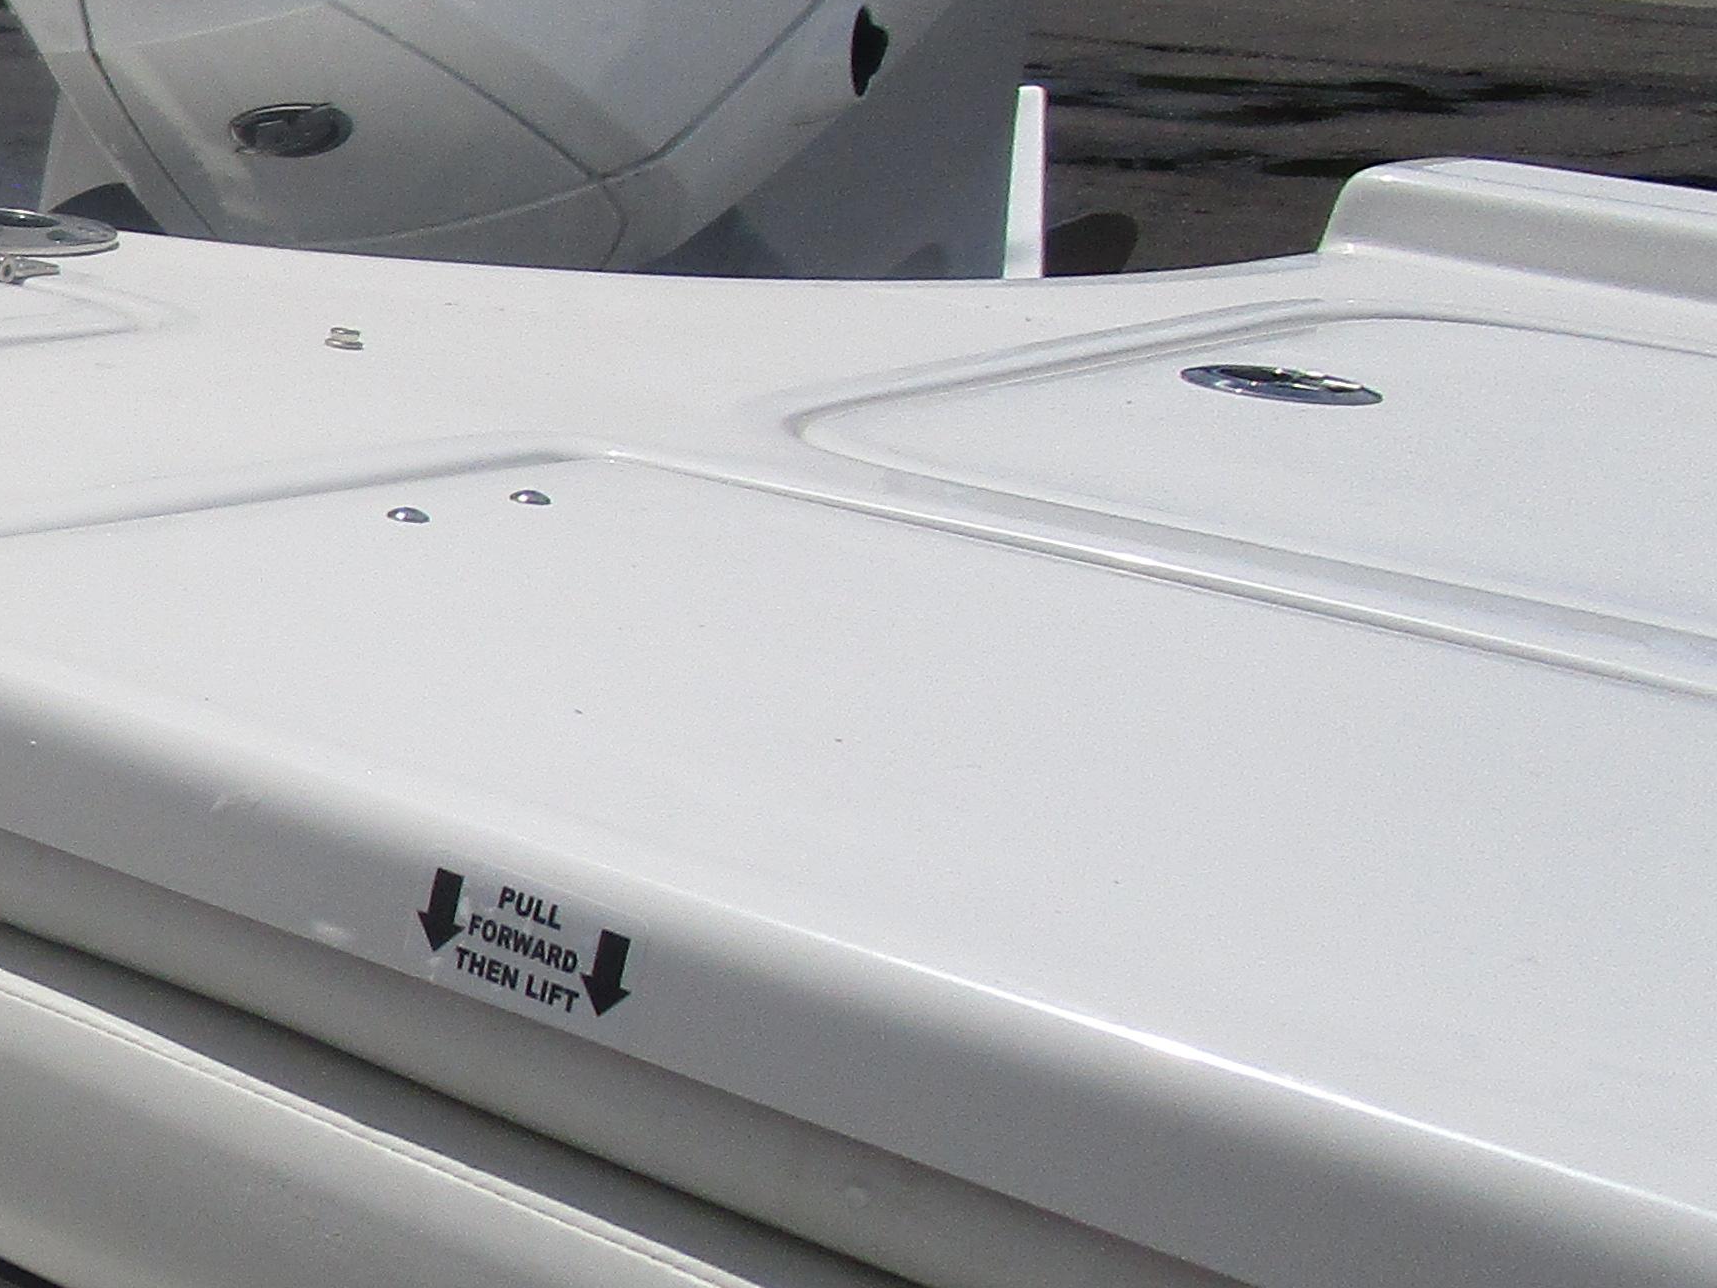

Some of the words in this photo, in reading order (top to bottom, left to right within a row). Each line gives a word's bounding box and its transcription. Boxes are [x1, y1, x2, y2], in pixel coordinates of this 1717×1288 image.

[497, 885, 562, 930] PULL
[467, 912, 579, 974] FORWARD
[454, 945, 519, 990] THEN
[524, 973, 580, 1013] LIFT
